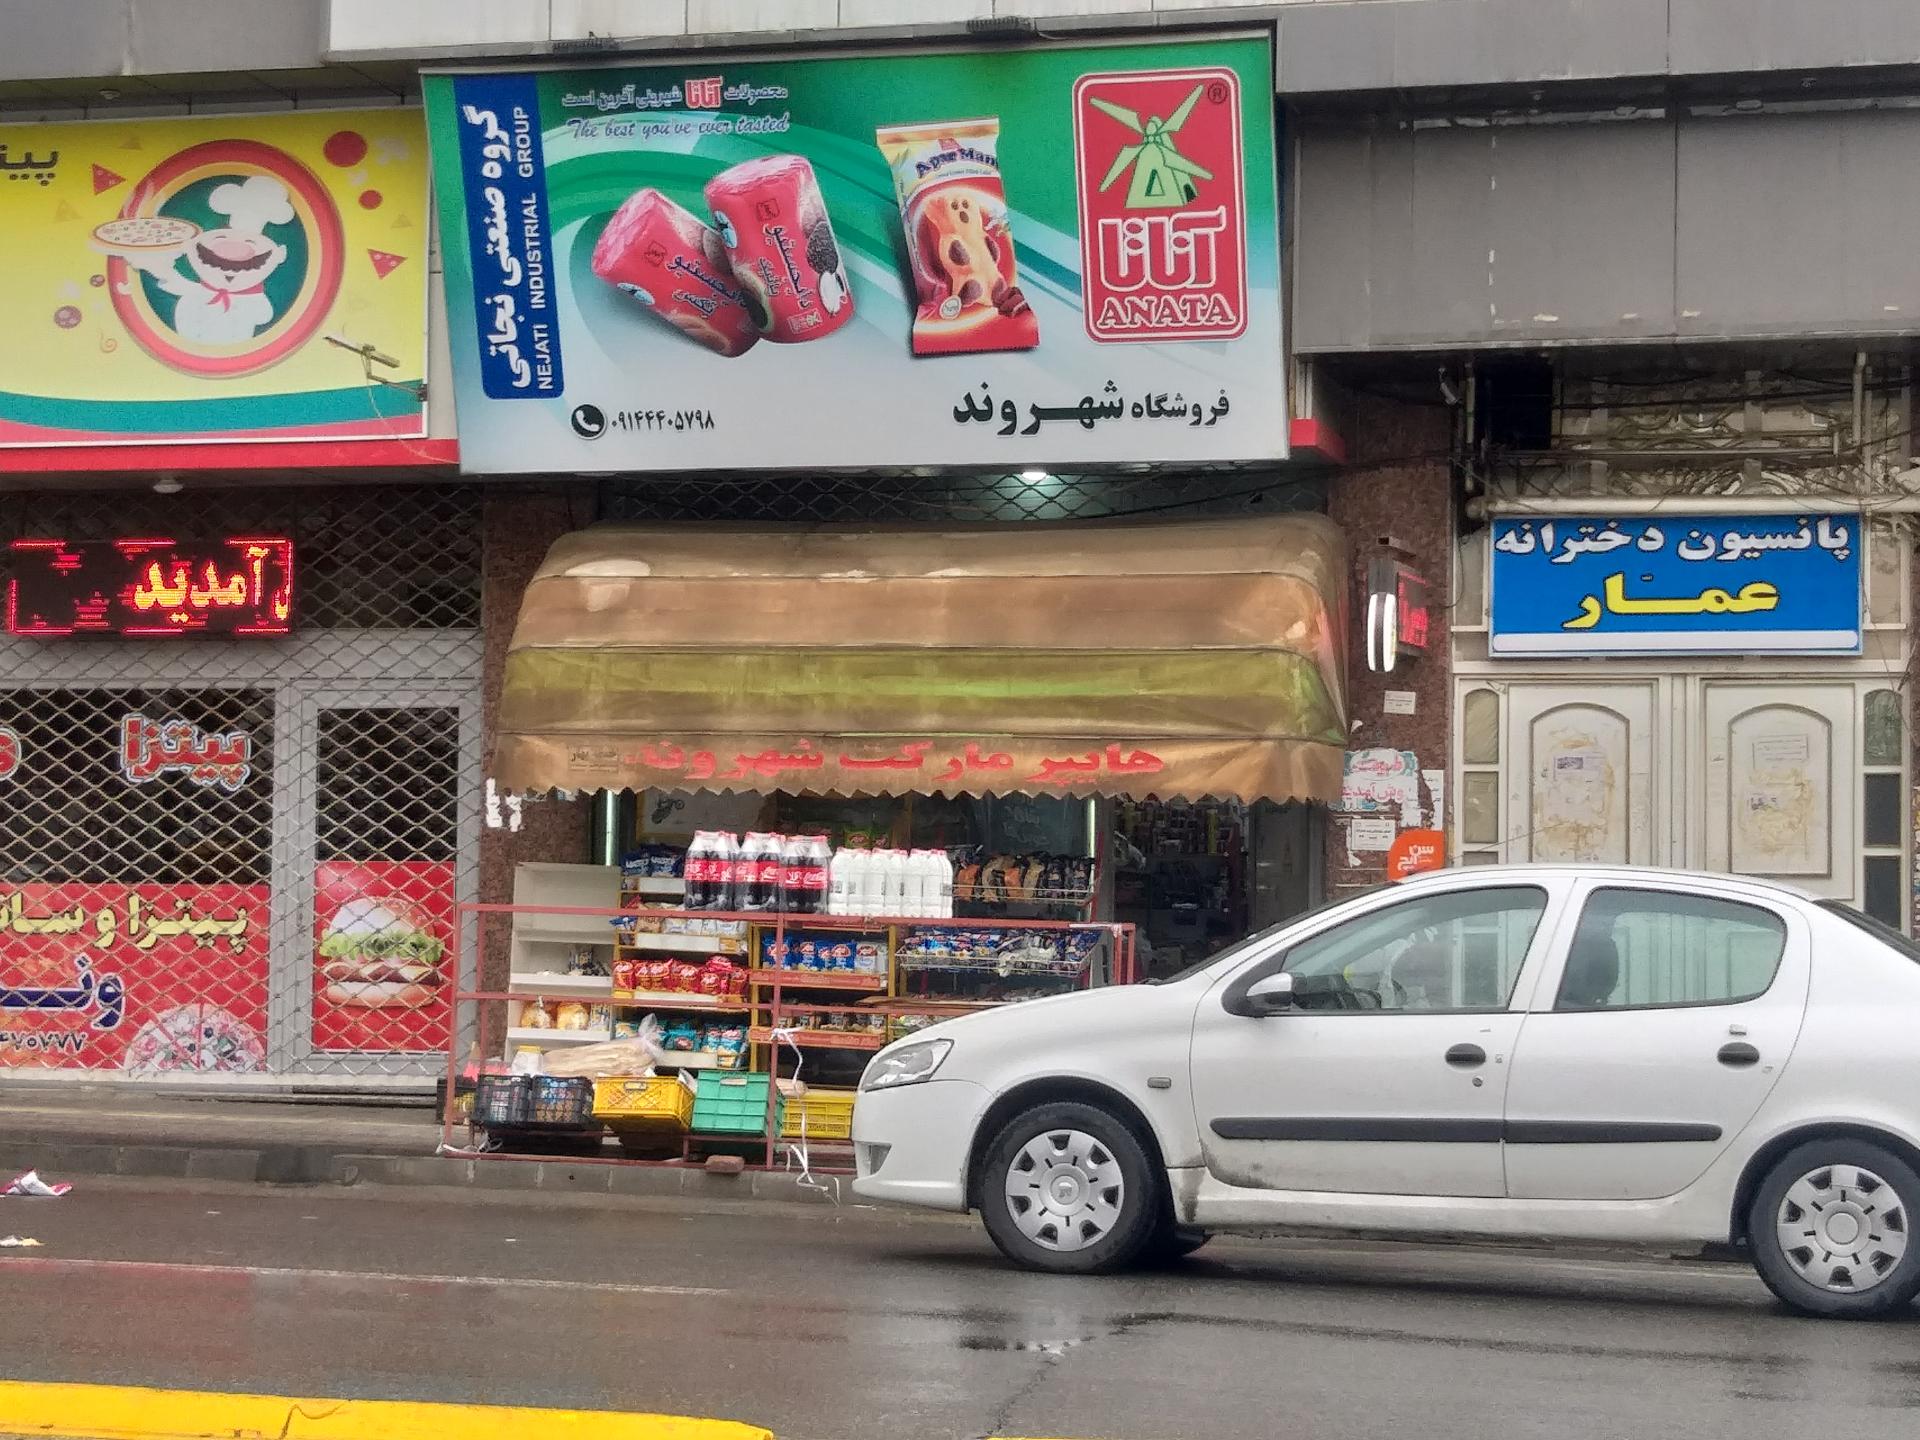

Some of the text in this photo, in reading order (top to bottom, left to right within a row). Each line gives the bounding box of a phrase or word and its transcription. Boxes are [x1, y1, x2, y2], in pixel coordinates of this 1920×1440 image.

[562, 77, 788, 110] محصولات آناتا شیرینی آفرین است
[566, 113, 790, 140] The best you've ever tasted
[463, 104, 532, 389] گروه صنعتی نجاتی
[513, 106, 553, 391] NEJATI INDUSTRIAL GROUP
[1096, 293, 1236, 329] ANATA
[611, 409, 715, 431] ۰۹۱۴۴۴۰۵۷۹۸
[953, 379, 1230, 436] فروشگاه شهروند
[1495, 515, 1850, 564] پانسیون دخترانه
[121, 714, 250, 790] پیتزا
[1025, 742, 1164, 786] هایپر
[92, 906, 117, 949] و
[128, 893, 248, 955] پیتزا
